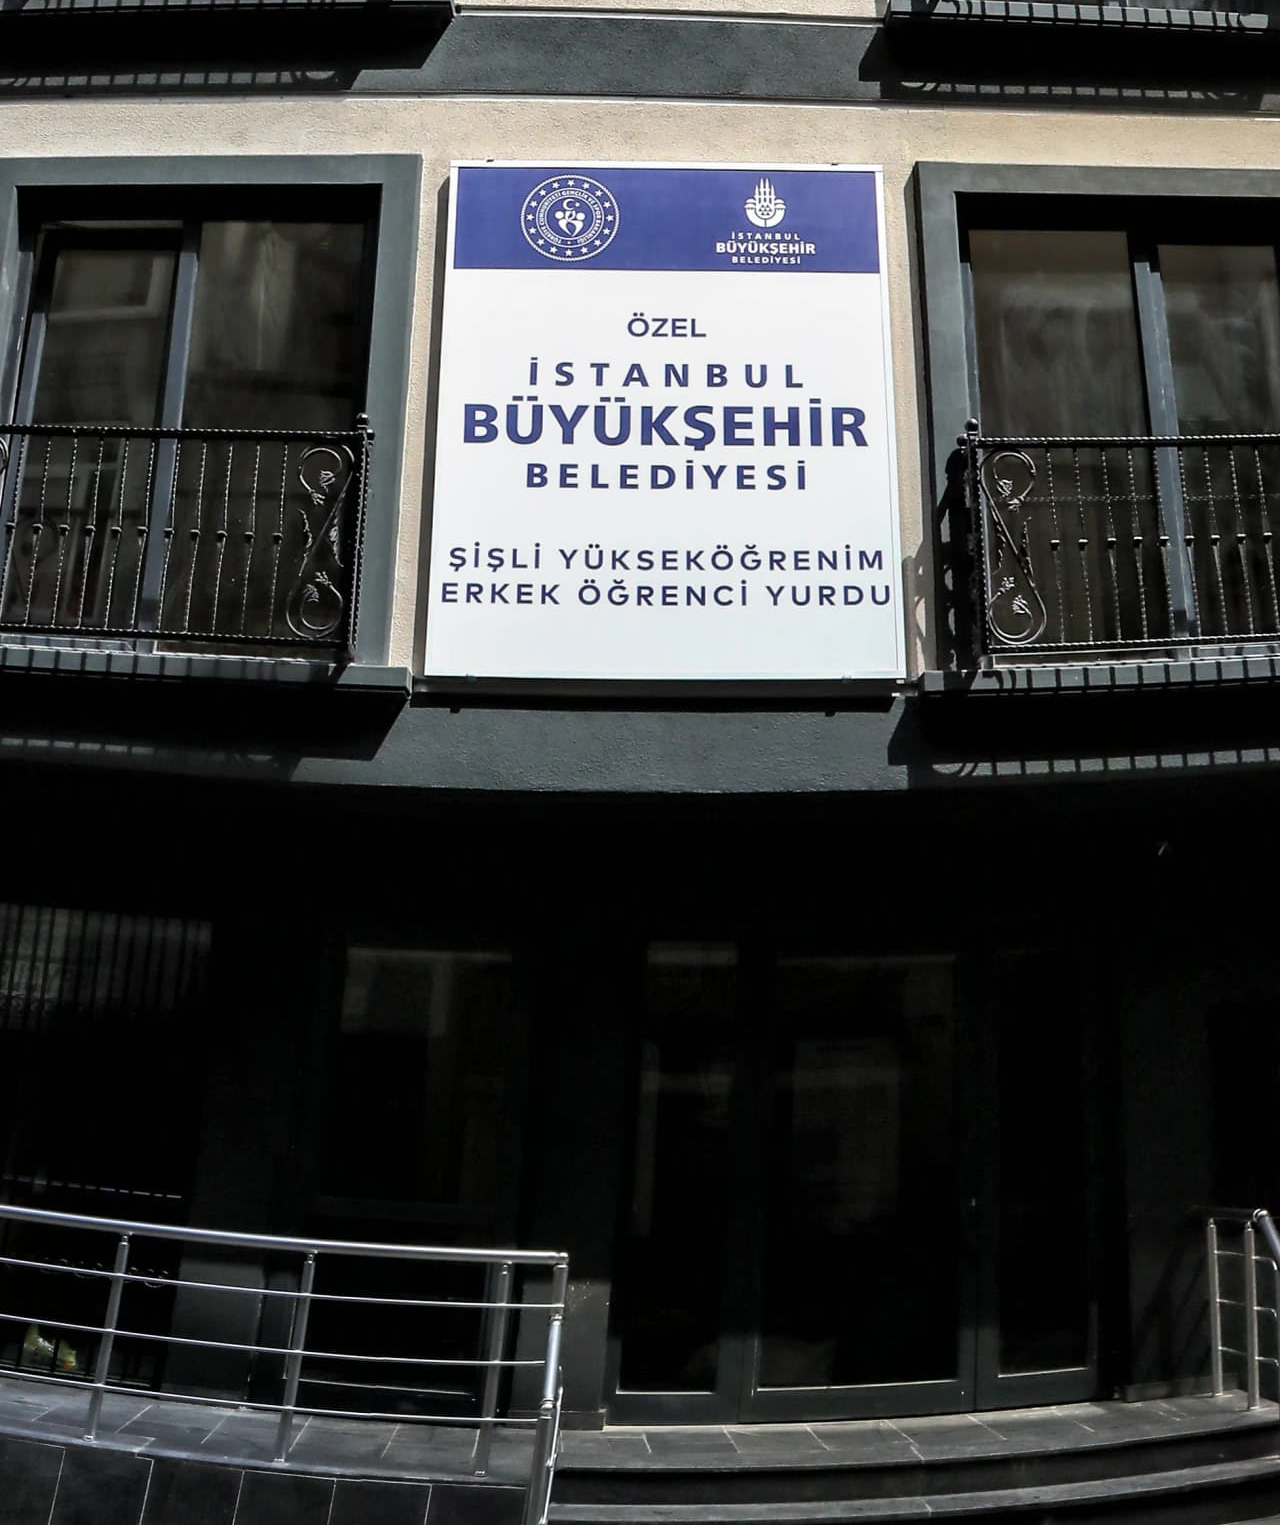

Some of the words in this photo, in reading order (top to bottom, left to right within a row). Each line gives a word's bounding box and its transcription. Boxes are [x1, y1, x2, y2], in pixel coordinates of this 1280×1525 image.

[716, 240, 816, 255] BÜYÜKŞEHİR
[731, 231, 801, 240] İSTANBUL
[731, 255, 801, 264] BELEDİYESİ
[627, 313, 707, 338] ÖZEL
[528, 356, 804, 388] İSTANBUL
[463, 394, 869, 450] BÜYÜKŞEHİR
[526, 459, 808, 490] BELEDİYESİ
[449, 541, 542, 572] ŞİŞLİ
[560, 543, 884, 571] YÜKSEKÖĞRENİM
[441, 582, 561, 605] ERKEK
[578, 577, 749, 607] ÖĞRENCİ
[766, 583, 891, 607] YURDU
